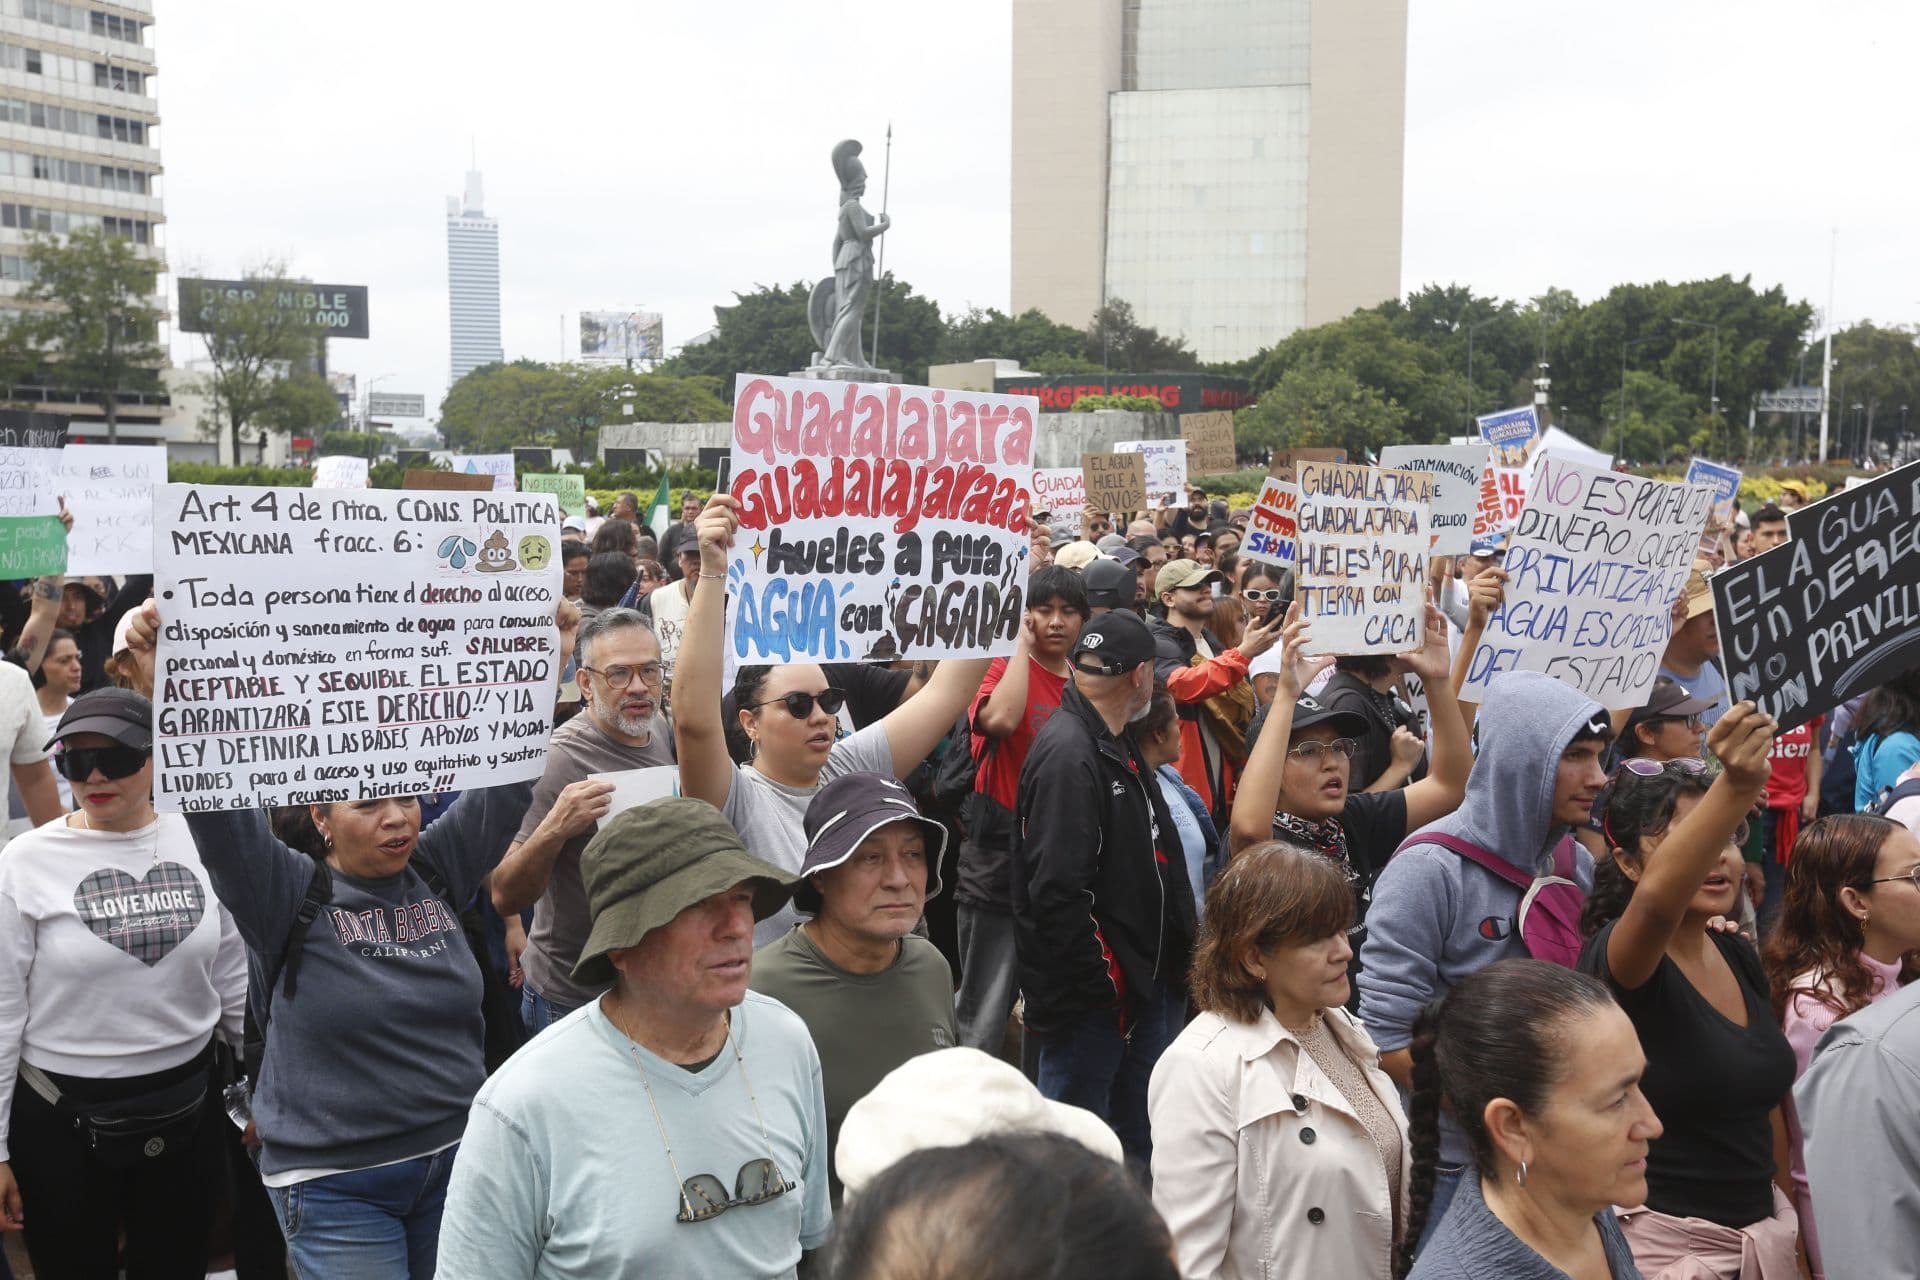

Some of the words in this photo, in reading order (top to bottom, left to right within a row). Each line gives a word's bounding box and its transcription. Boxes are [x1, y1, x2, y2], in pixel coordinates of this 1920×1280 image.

[202, 289, 347, 310] DISPNIBLE
[735, 379, 1033, 472] Guadalajara
[1091, 457, 1106, 472] EL
[1108, 455, 1134, 470] AGUA
[1093, 472, 1125, 489] HUELE
[1130, 473, 1138, 485] A
[1394, 459, 1479, 486] NTAMINACIÓN
[1102, 490, 1131, 510] OVO
[1302, 465, 1432, 506] GUADALAJARA
[1533, 459, 1584, 507] NO
[1583, 476, 1634, 516] ES
[1627, 481, 1663, 526] POR
[179, 490, 242, 523] Art.
[251, 491, 279, 522] 4
[288, 492, 322, 522] de
[396, 498, 463, 523] CONS.
[473, 498, 557, 525] POLITICA
[1300, 503, 1419, 535] GUADALAJARA
[171, 530, 293, 555] MEXICANA
[314, 528, 384, 553] fracc.
[393, 530, 423, 553] 6:
[767, 526, 885, 576] hueles
[894, 531, 922, 577] a
[1517, 508, 1632, 556] DINERO
[1300, 543, 1371, 578] HUELES
[1372, 541, 1381, 561] A
[1383, 549, 1424, 583] PURA
[1724, 564, 1781, 626] EL
[1788, 487, 1900, 586] AGUA
[178, 577, 254, 609] Toda
[265, 588, 351, 615] persona
[356, 583, 399, 604] tiene
[404, 581, 416, 604] el
[420, 583, 483, 605] derecho
[488, 580, 500, 601] al
[1300, 585, 1365, 617] TIERRA
[1374, 585, 1401, 604] CON
[165, 619, 270, 650] disposición
[276, 625, 289, 643] y
[292, 619, 390, 637] saneamiento
[396, 617, 415, 633] de
[418, 618, 456, 639] agua
[464, 616, 494, 635] para
[734, 578, 836, 663] AGUA
[840, 602, 883, 634] con
[895, 580, 1022, 654] CAGADA
[1365, 615, 1416, 646] CACA
[1487, 601, 1569, 643] AGUA
[1573, 611, 1613, 648] ES
[166, 650, 239, 675] personal
[242, 655, 256, 675] y
[262, 648, 336, 666] doméstico
[345, 649, 361, 662] en
[365, 640, 414, 661] forma
[421, 640, 452, 657] suf.
[466, 636, 555, 657] SALUBRE,
[1757, 671, 1809, 722] UN
[1807, 581, 1920, 687] PRIVIL
[163, 676, 285, 703] ACEPTABLE
[295, 674, 310, 694] Y
[421, 663, 450, 688] EL
[457, 659, 549, 685] ESTADO
[1545, 651, 1656, 695] ESTADO
[1732, 652, 1788, 700] NO
[159, 699, 312, 737] GARANTIZARÁ
[322, 700, 370, 725] ESTE
[496, 691, 509, 715] Y
[513, 688, 534, 714] LA
[161, 739, 207, 769] LEY
[218, 733, 320, 765] DEFINIRA
[327, 732, 359, 755] LAS
[420, 724, 480, 748] APOYOS
[488, 721, 500, 741] Y
[161, 772, 233, 793] LIDADES
[249, 770, 288, 791] para
[294, 764, 306, 781] el
[314, 764, 359, 781] acceso
[364, 764, 375, 779] y
[382, 760, 408, 776] uso
[414, 752, 481, 778] equitativo
[487, 754, 498, 769] y
[178, 795, 223, 812] table
[230, 793, 251, 808] de
[258, 791, 279, 808] los
[287, 787, 349, 806] recursos
[90, 894, 143, 918] LOVE
[142, 890, 195, 913] MORE
